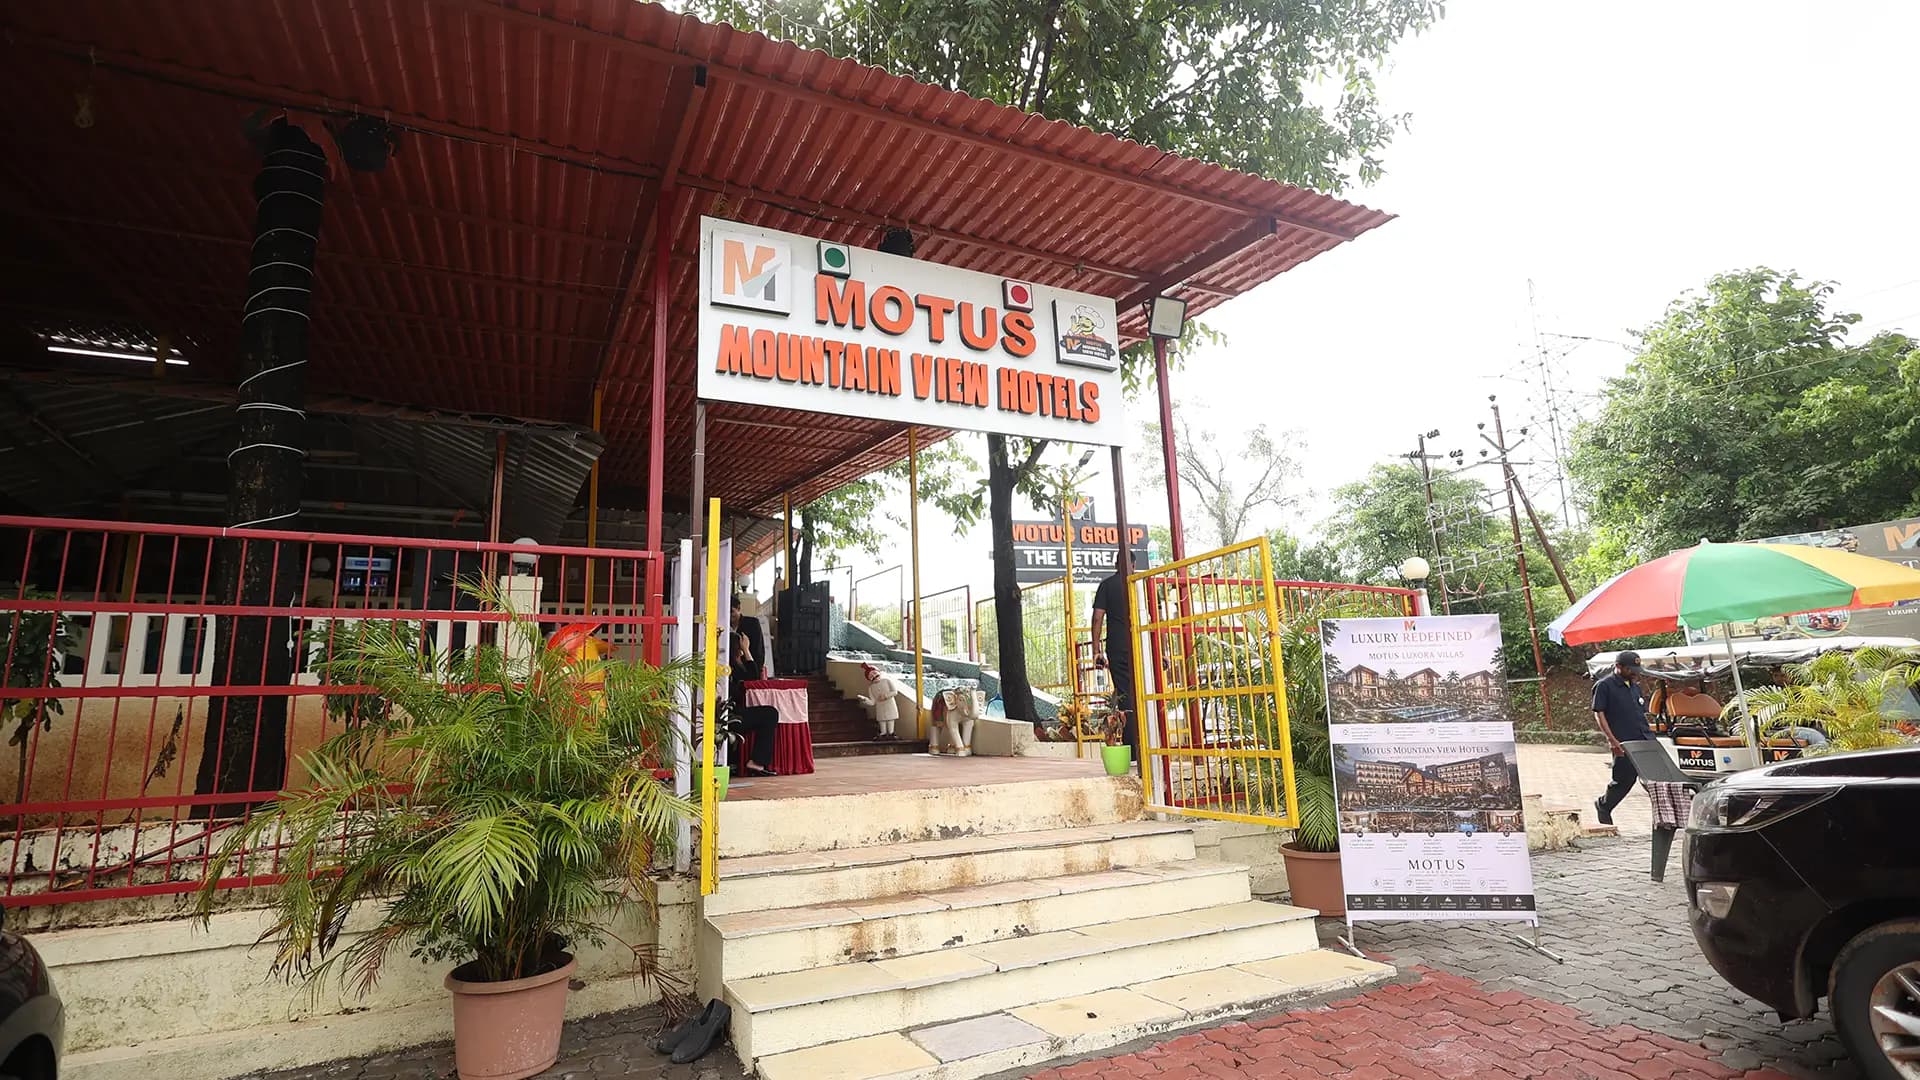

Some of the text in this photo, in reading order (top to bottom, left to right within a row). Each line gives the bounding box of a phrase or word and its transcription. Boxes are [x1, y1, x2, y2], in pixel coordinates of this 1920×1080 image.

[814, 273, 1037, 358] MOTUS
[715, 323, 1100, 424] MOUNTAIN VIEW HOTELS
[1081, 526, 1144, 545] GROP
[1024, 550, 1057, 565] THE
[1887, 608, 1918, 616] LUXURY
[1351, 631, 1472, 644] LUXURY REDEFINED
[1369, 652, 1399, 660] MOTUS
[1437, 650, 1465, 659] VILLAS
[1680, 758, 1714, 767] MOTUS
[1408, 859, 1465, 871] MOTUS
